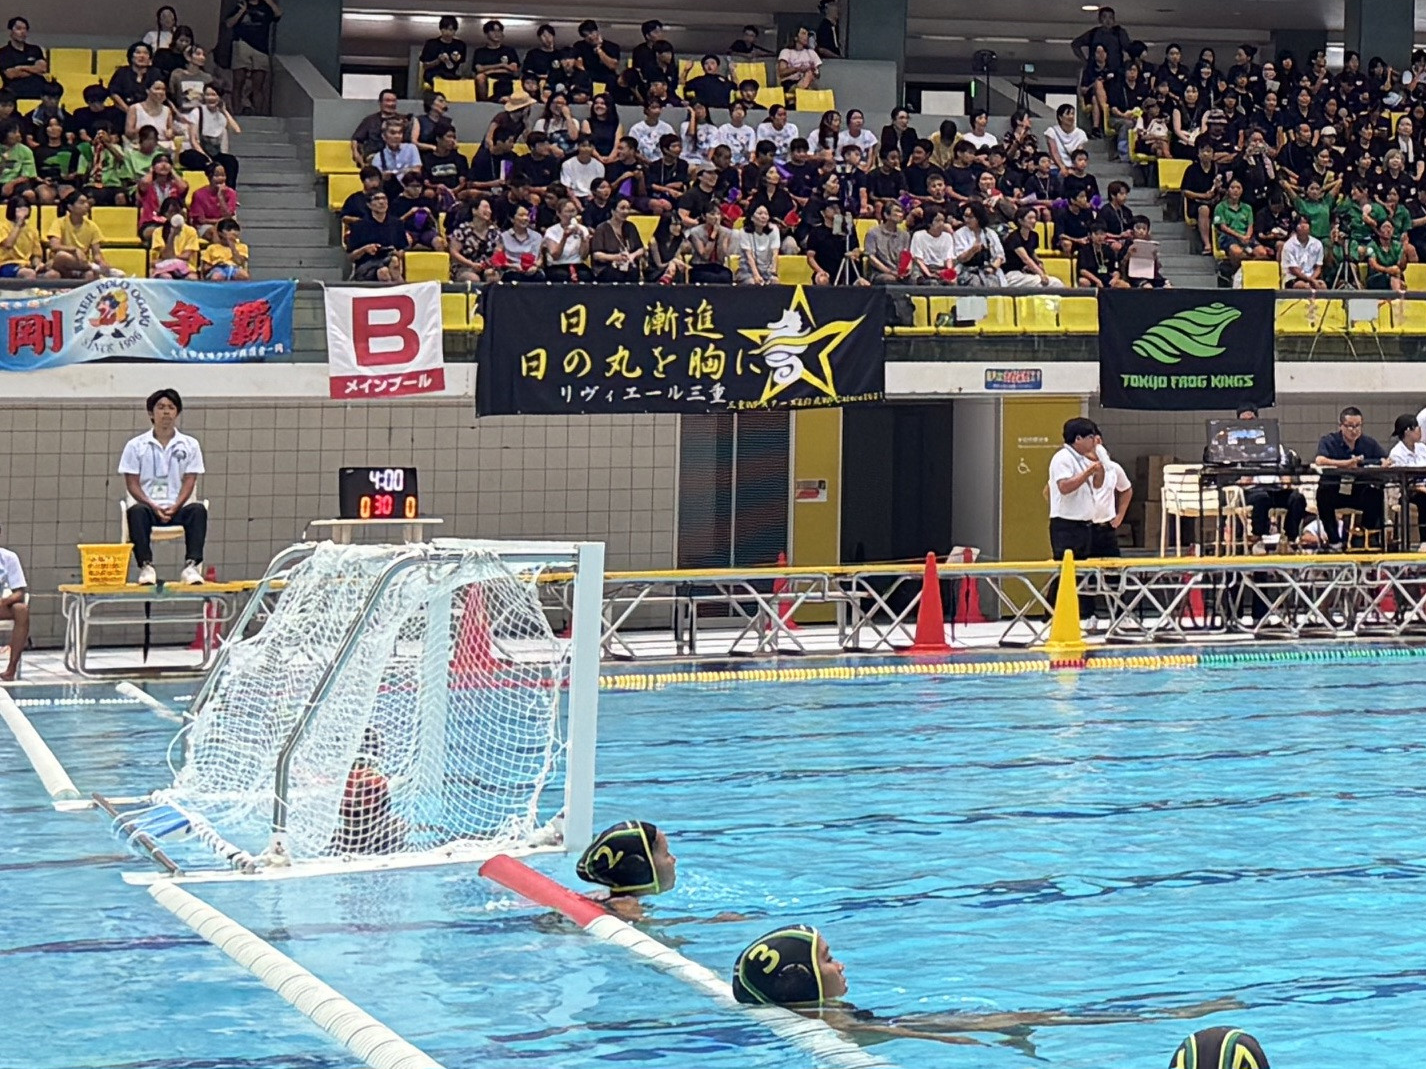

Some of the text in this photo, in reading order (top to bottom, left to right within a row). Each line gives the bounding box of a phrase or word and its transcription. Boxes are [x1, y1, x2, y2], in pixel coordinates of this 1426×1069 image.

[8, 309, 63, 356] 剛
[352, 294, 420, 367] B
[560, 298, 724, 340] 日々漸進
[521, 342, 762, 380] 日の丸を胸に
[561, 383, 728, 405] リヴィエール三重
[1120, 374, 1255, 390] TOKYO FROG KINGS
[369, 469, 404, 491] 4:00
[360, 494, 416, 518] 0 30 0
[594, 845, 624, 869] 2
[749, 943, 781, 974] 3
